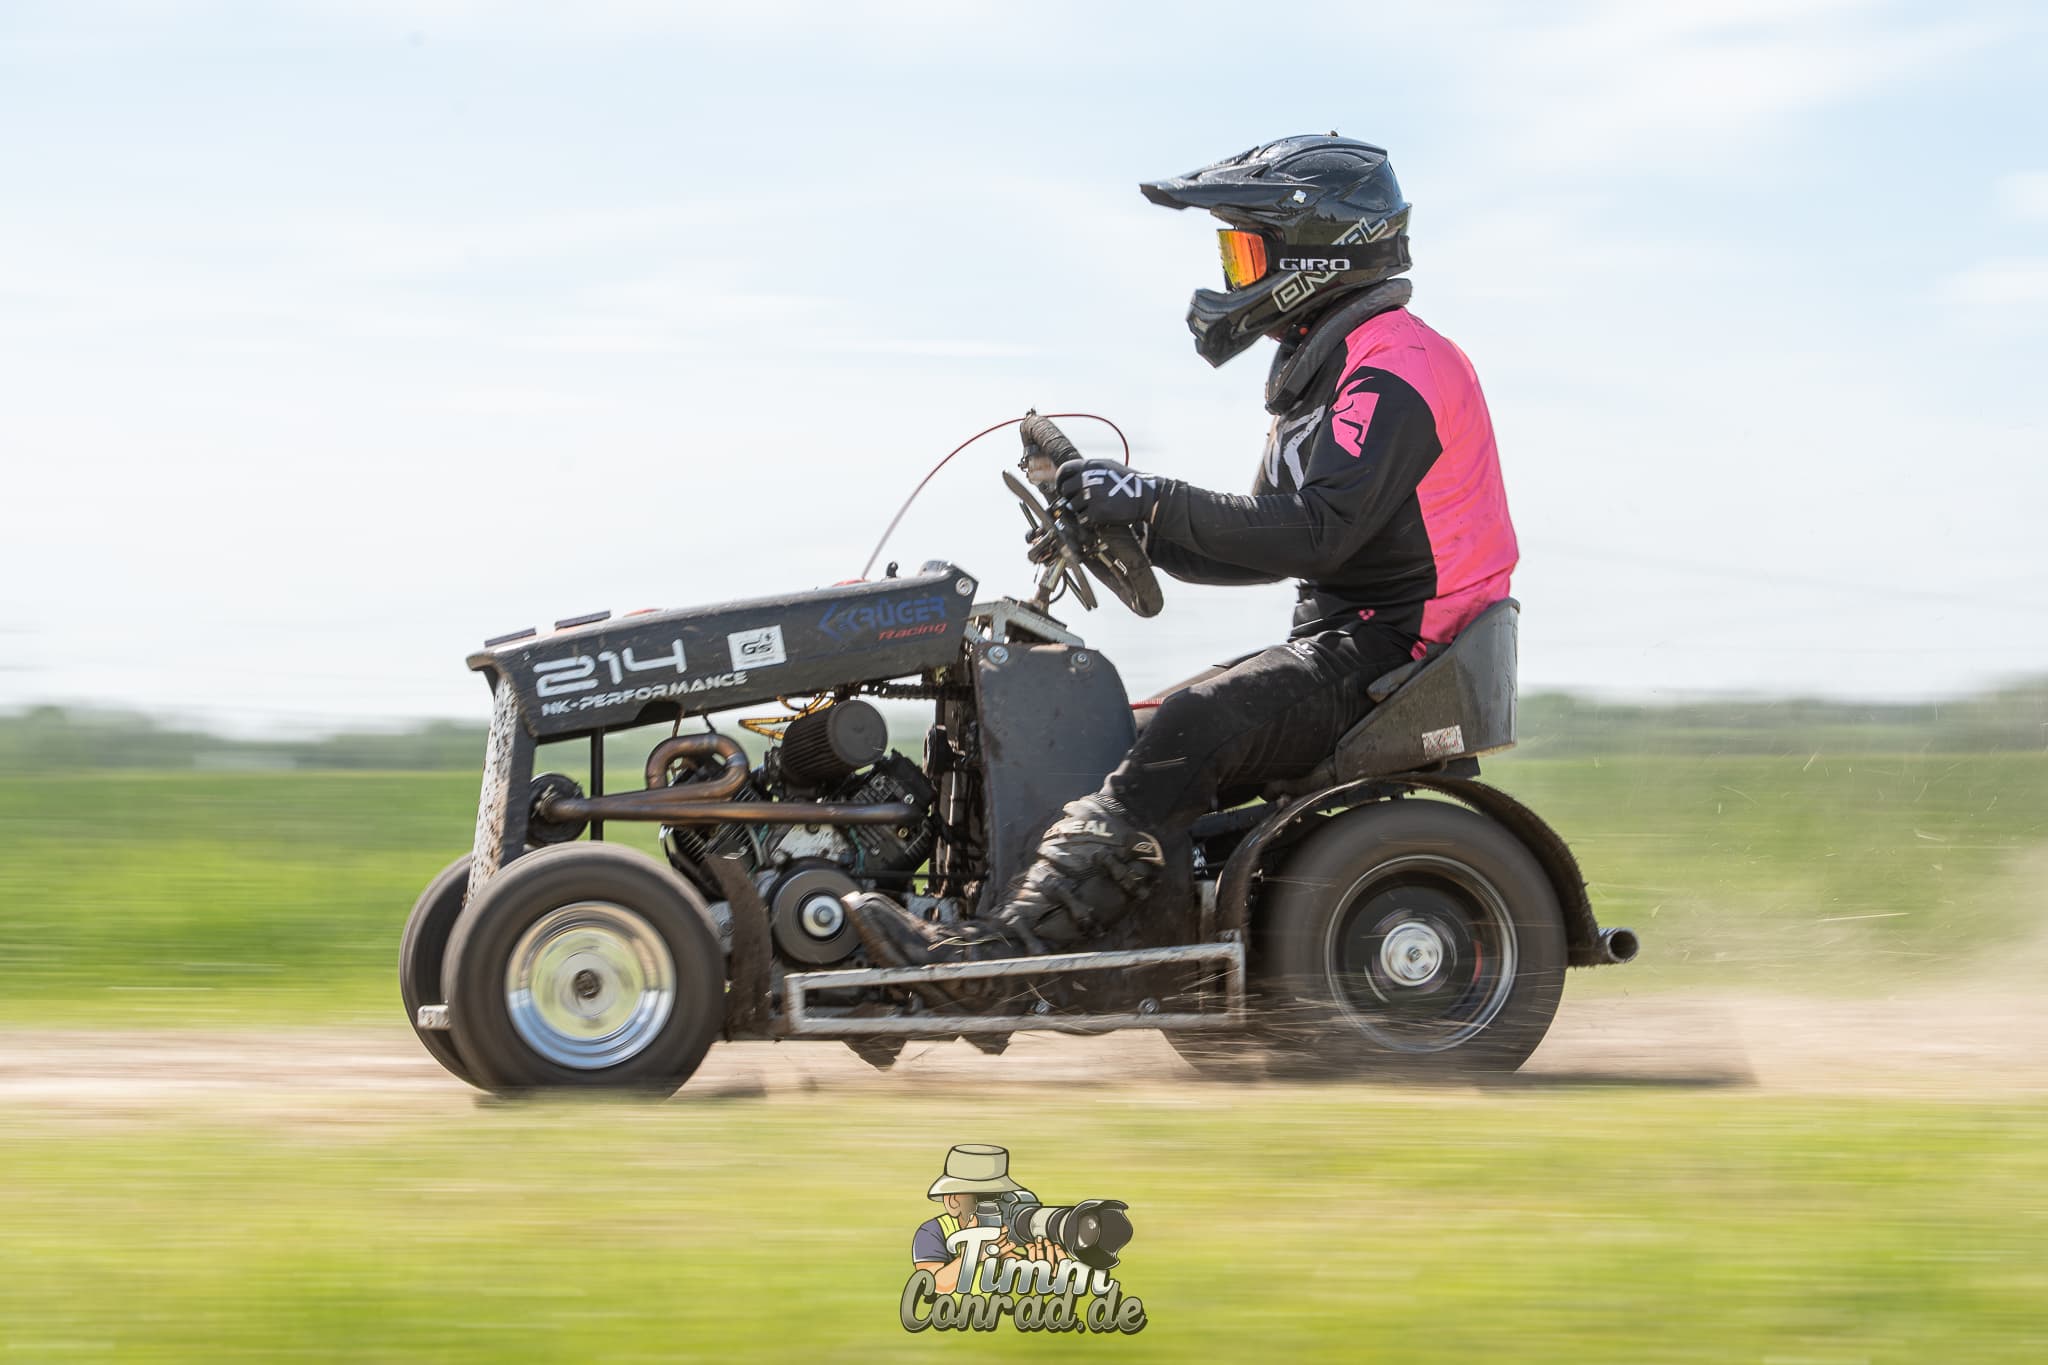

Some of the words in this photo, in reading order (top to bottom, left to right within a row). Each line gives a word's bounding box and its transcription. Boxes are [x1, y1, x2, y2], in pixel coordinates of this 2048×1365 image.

[1272, 217, 1388, 312] ONAL
[1280, 258, 1351, 271] GIRO
[879, 623, 948, 641] Racing
[533, 639, 688, 698] 214
